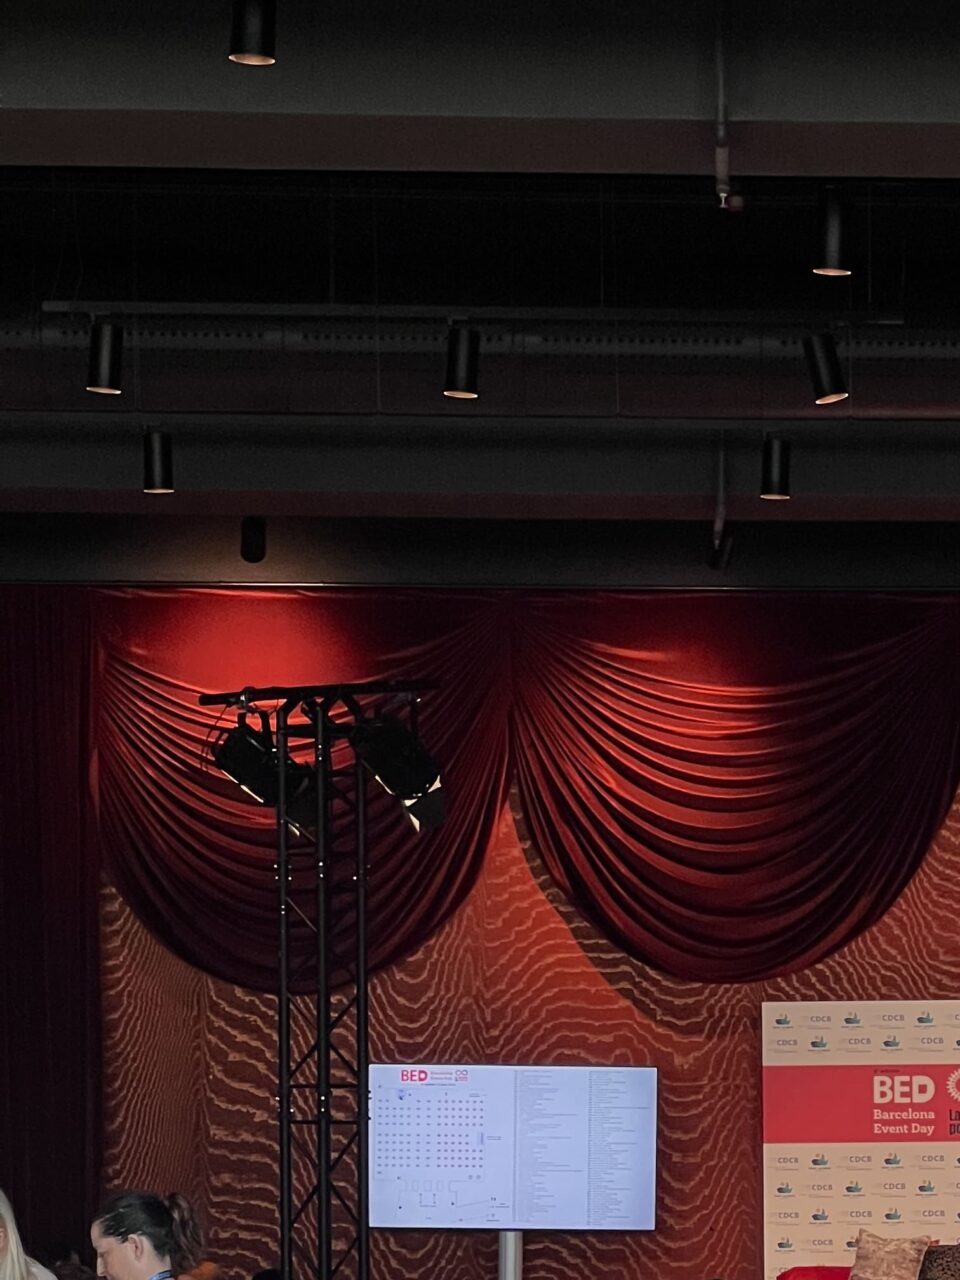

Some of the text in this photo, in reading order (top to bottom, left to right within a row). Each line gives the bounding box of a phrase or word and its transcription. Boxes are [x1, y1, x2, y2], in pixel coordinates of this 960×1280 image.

[401, 1069, 428, 1082] BED
[873, 1075, 935, 1104] BED
[873, 1108, 935, 1120] Barcelona
[949, 1109, 960, 1121] La
[873, 1123, 935, 1136] Event Day
